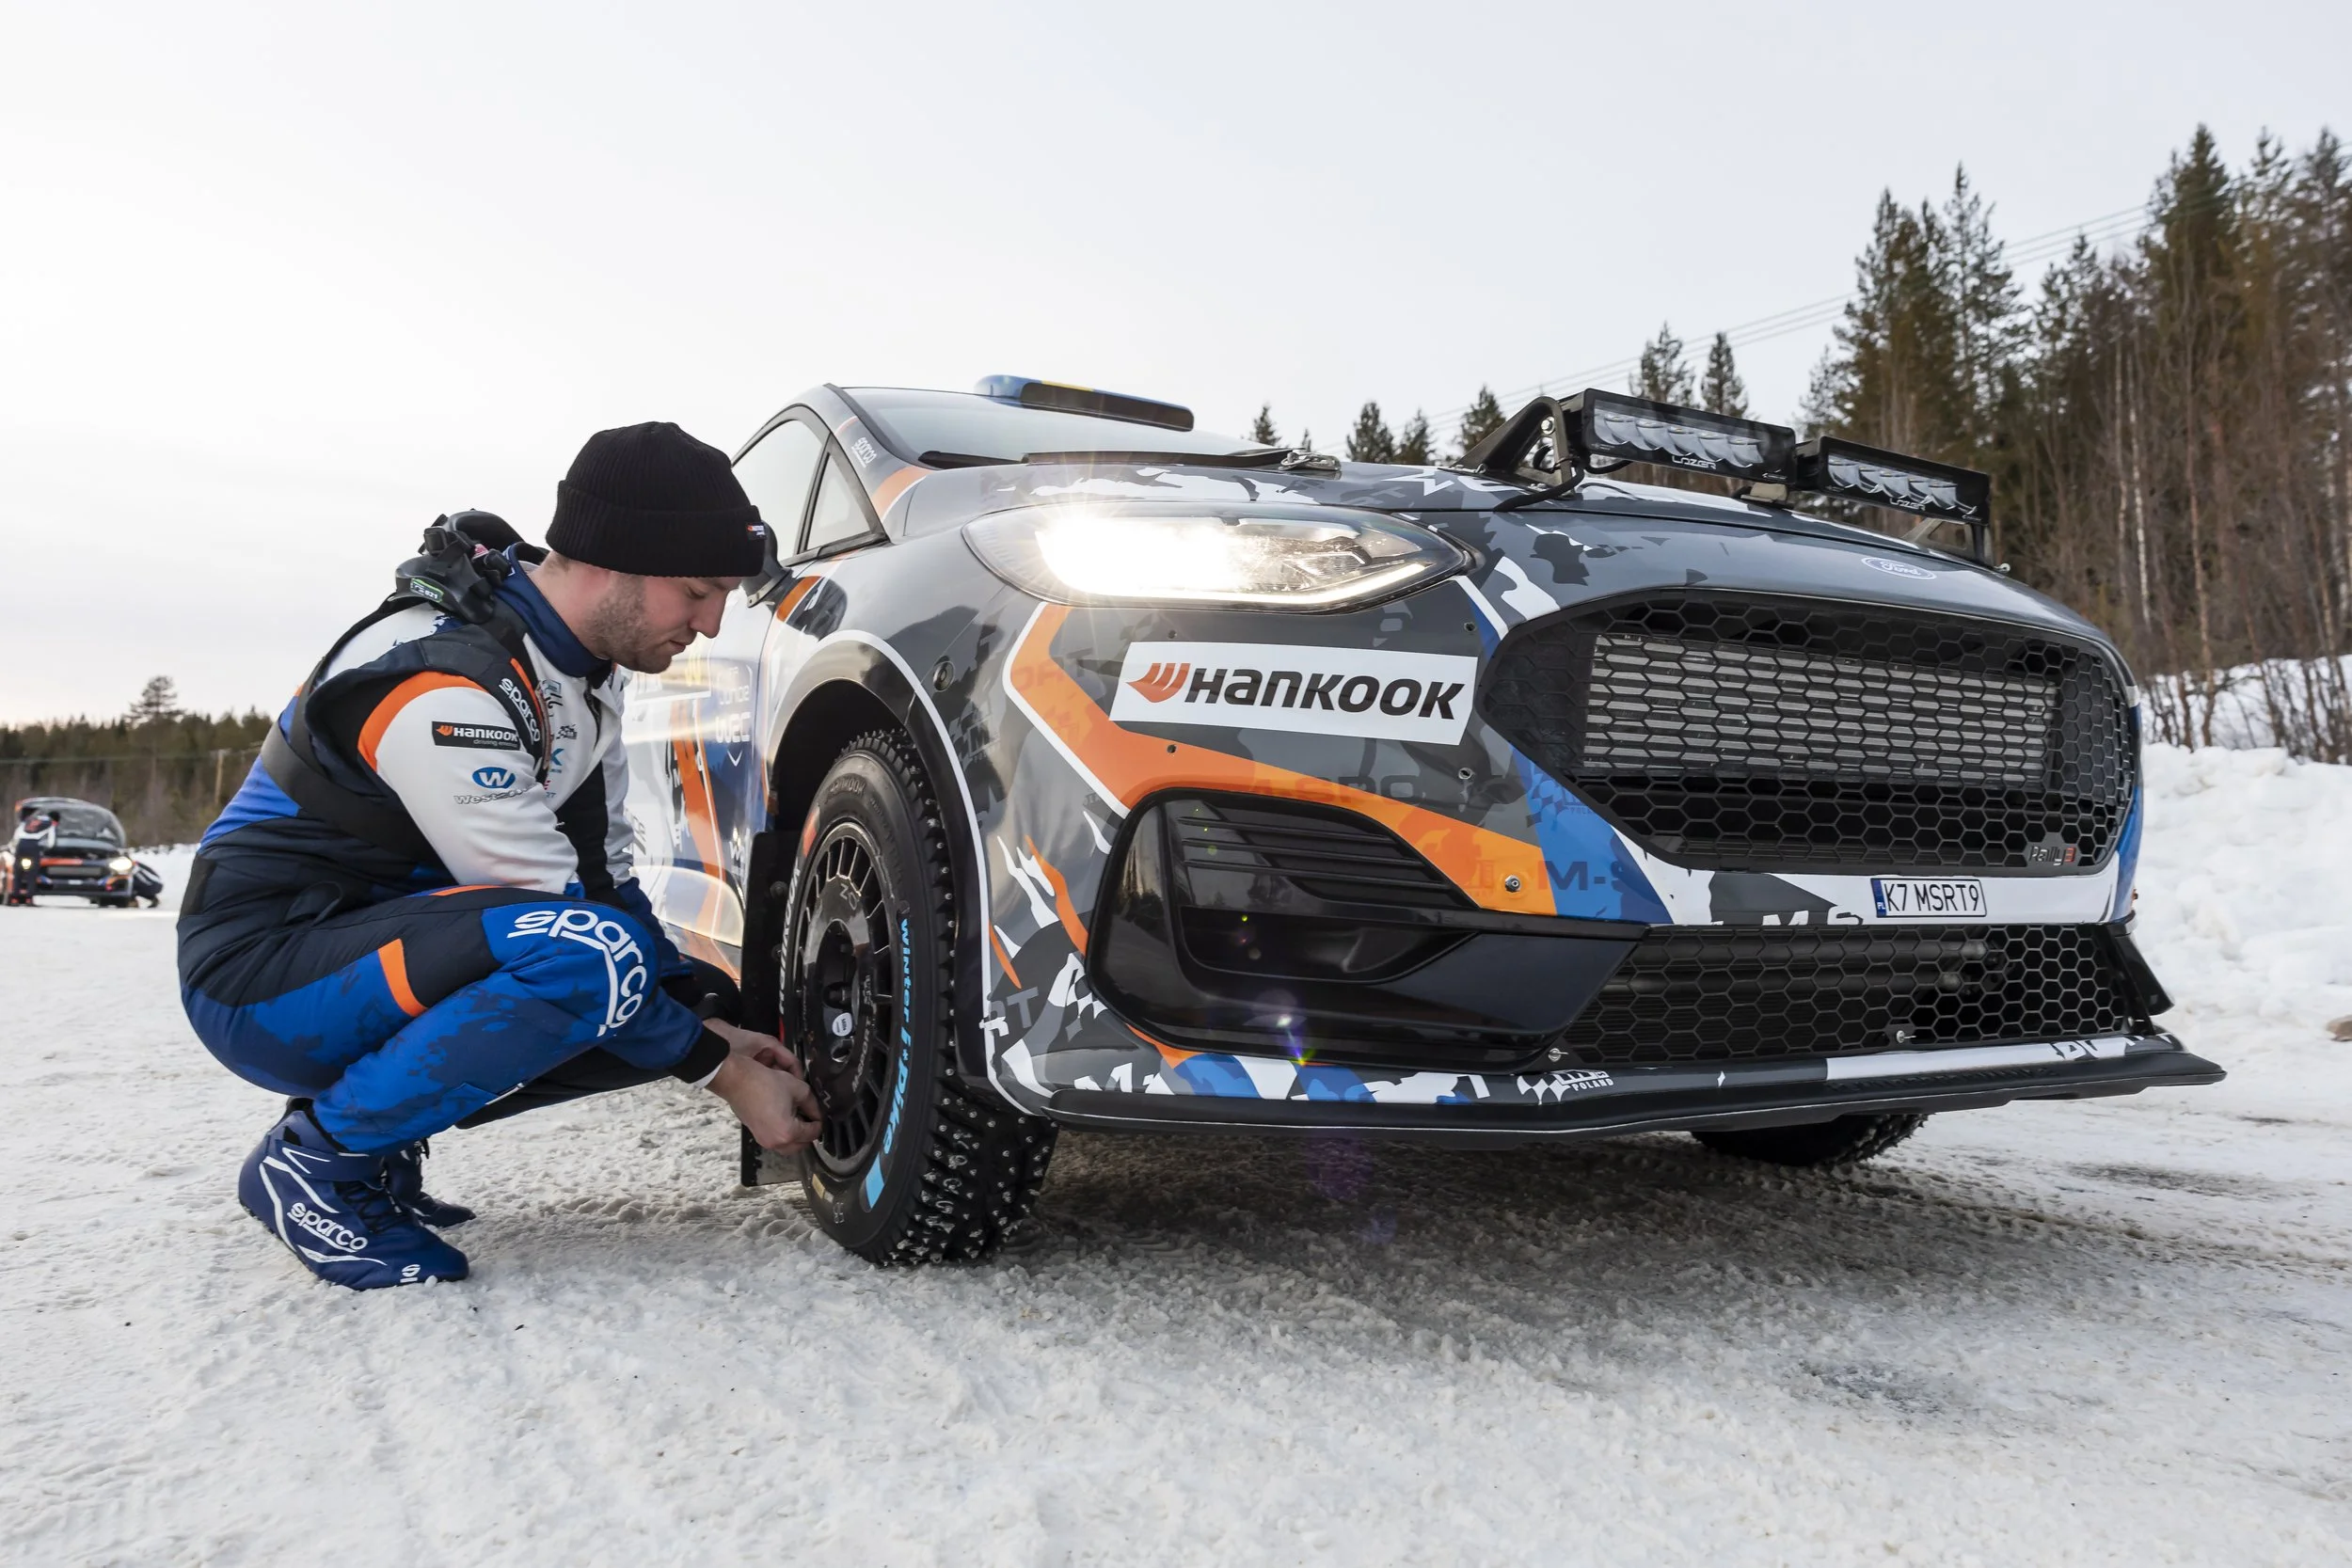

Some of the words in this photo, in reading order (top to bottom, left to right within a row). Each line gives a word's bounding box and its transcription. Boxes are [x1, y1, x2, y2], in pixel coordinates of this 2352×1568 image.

[500, 677, 540, 745] sparco
[1884, 883, 1908, 911] K7
[1915, 883, 1979, 912] MSRT9
[507, 909, 648, 1037] sparco
[1571, 1078, 1614, 1092] POLAND
[286, 1202, 369, 1253] sparco
